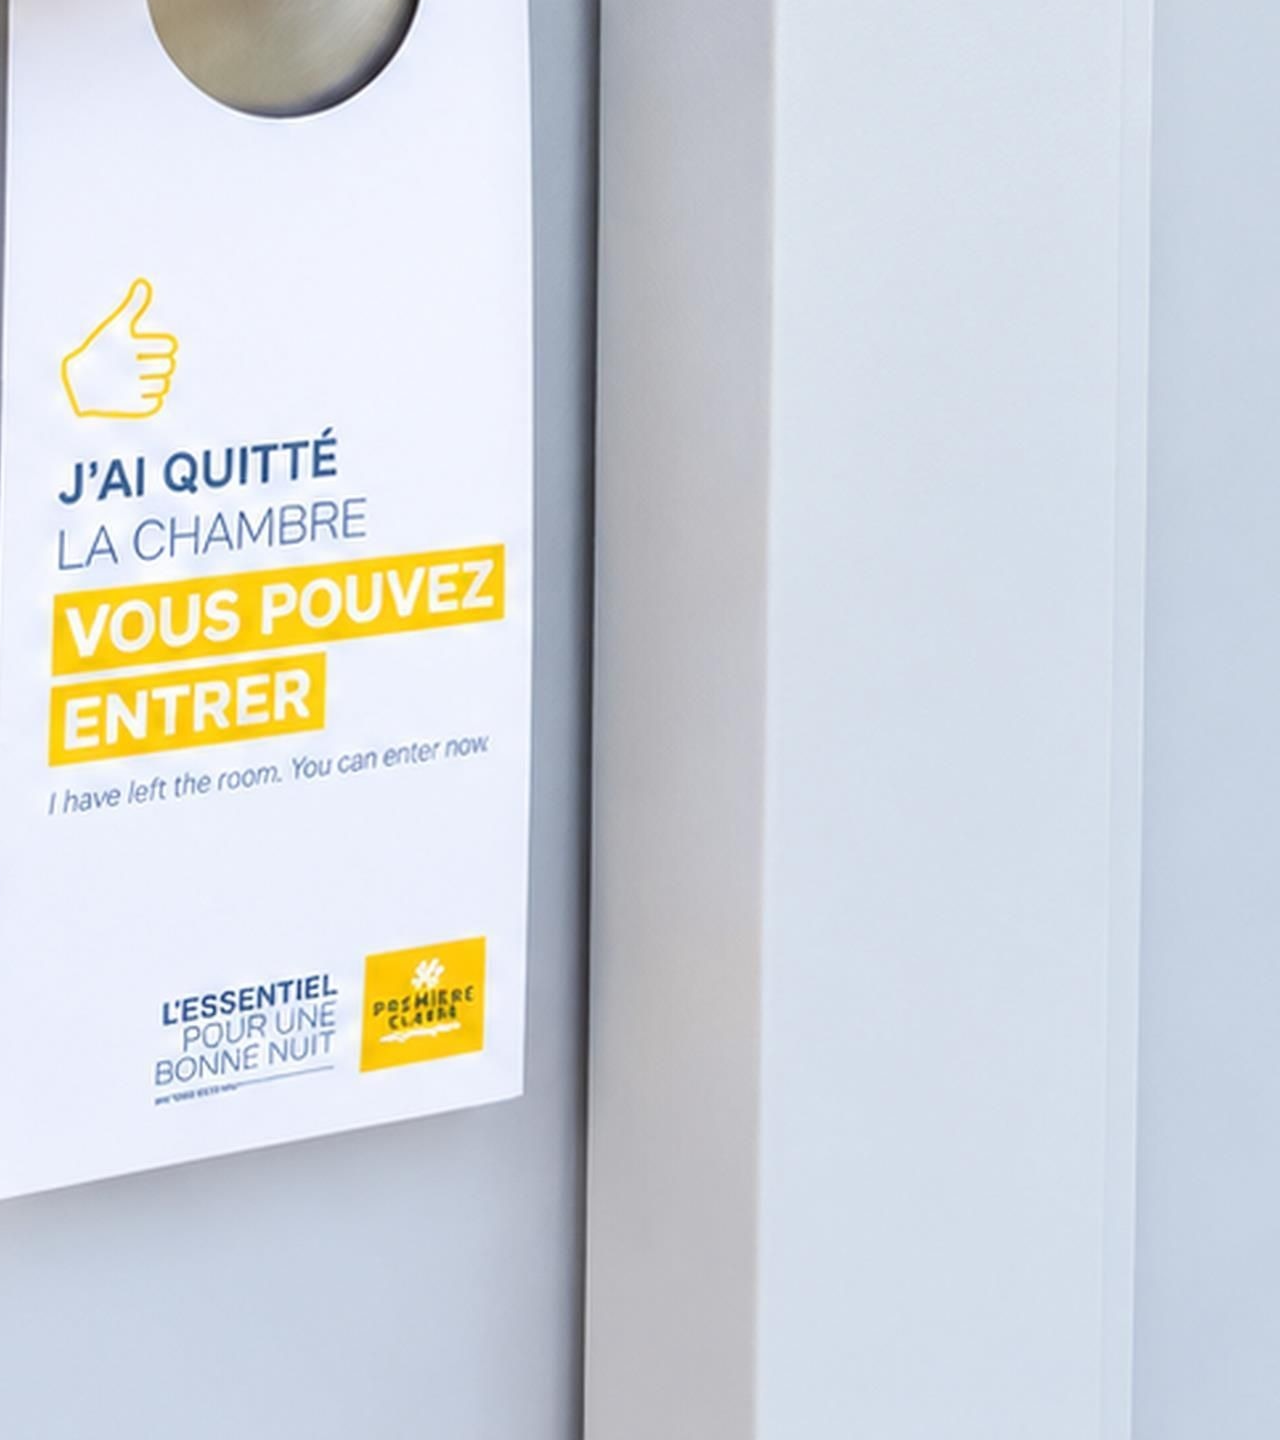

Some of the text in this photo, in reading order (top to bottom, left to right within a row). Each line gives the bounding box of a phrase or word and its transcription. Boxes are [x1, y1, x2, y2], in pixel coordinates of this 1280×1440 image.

[163, 427, 338, 494] QUITTÉ
[57, 498, 367, 571] LA CHAMBRE
[65, 559, 495, 658] VOUS POUVEZ
[63, 669, 312, 752] ENTRER
[47, 791, 57, 816] I
[62, 788, 122, 814] have
[127, 776, 167, 804] left
[174, 771, 212, 798] the
[217, 764, 283, 792] room.
[291, 755, 332, 780] You
[336, 750, 378, 774] can
[381, 740, 441, 767] enter
[154, 1029, 336, 1087] BONNE NUIT
[182, 1000, 337, 1052] POUR UNE
